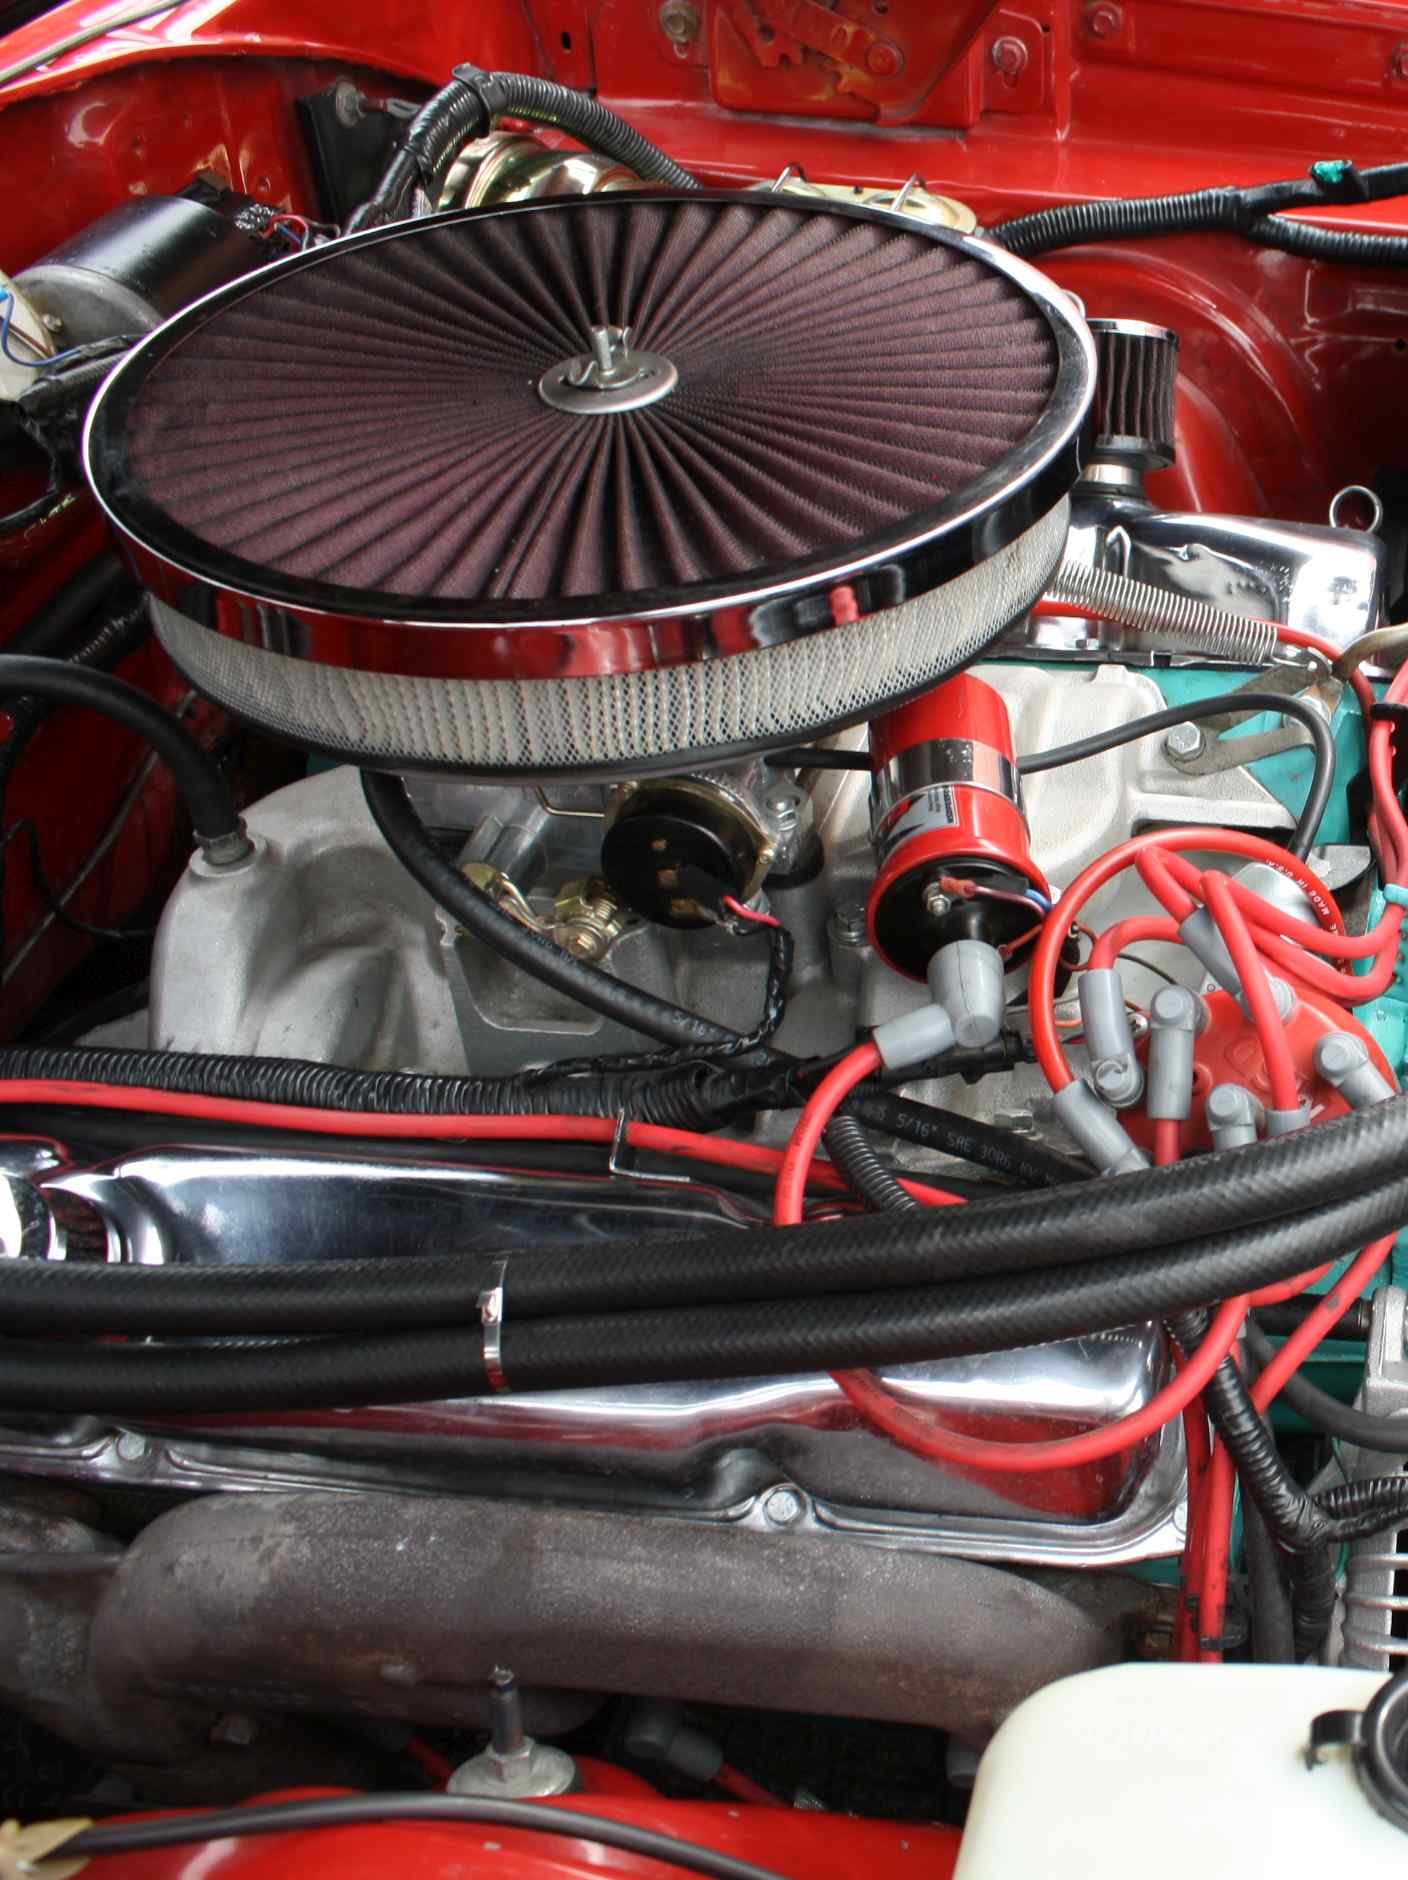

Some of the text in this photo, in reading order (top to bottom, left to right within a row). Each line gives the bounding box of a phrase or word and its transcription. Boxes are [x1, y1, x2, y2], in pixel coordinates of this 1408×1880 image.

[1296, 878, 1309, 889] IN
[1309, 890, 1331, 916] MADE
[945, 1131, 976, 1153] SAE
